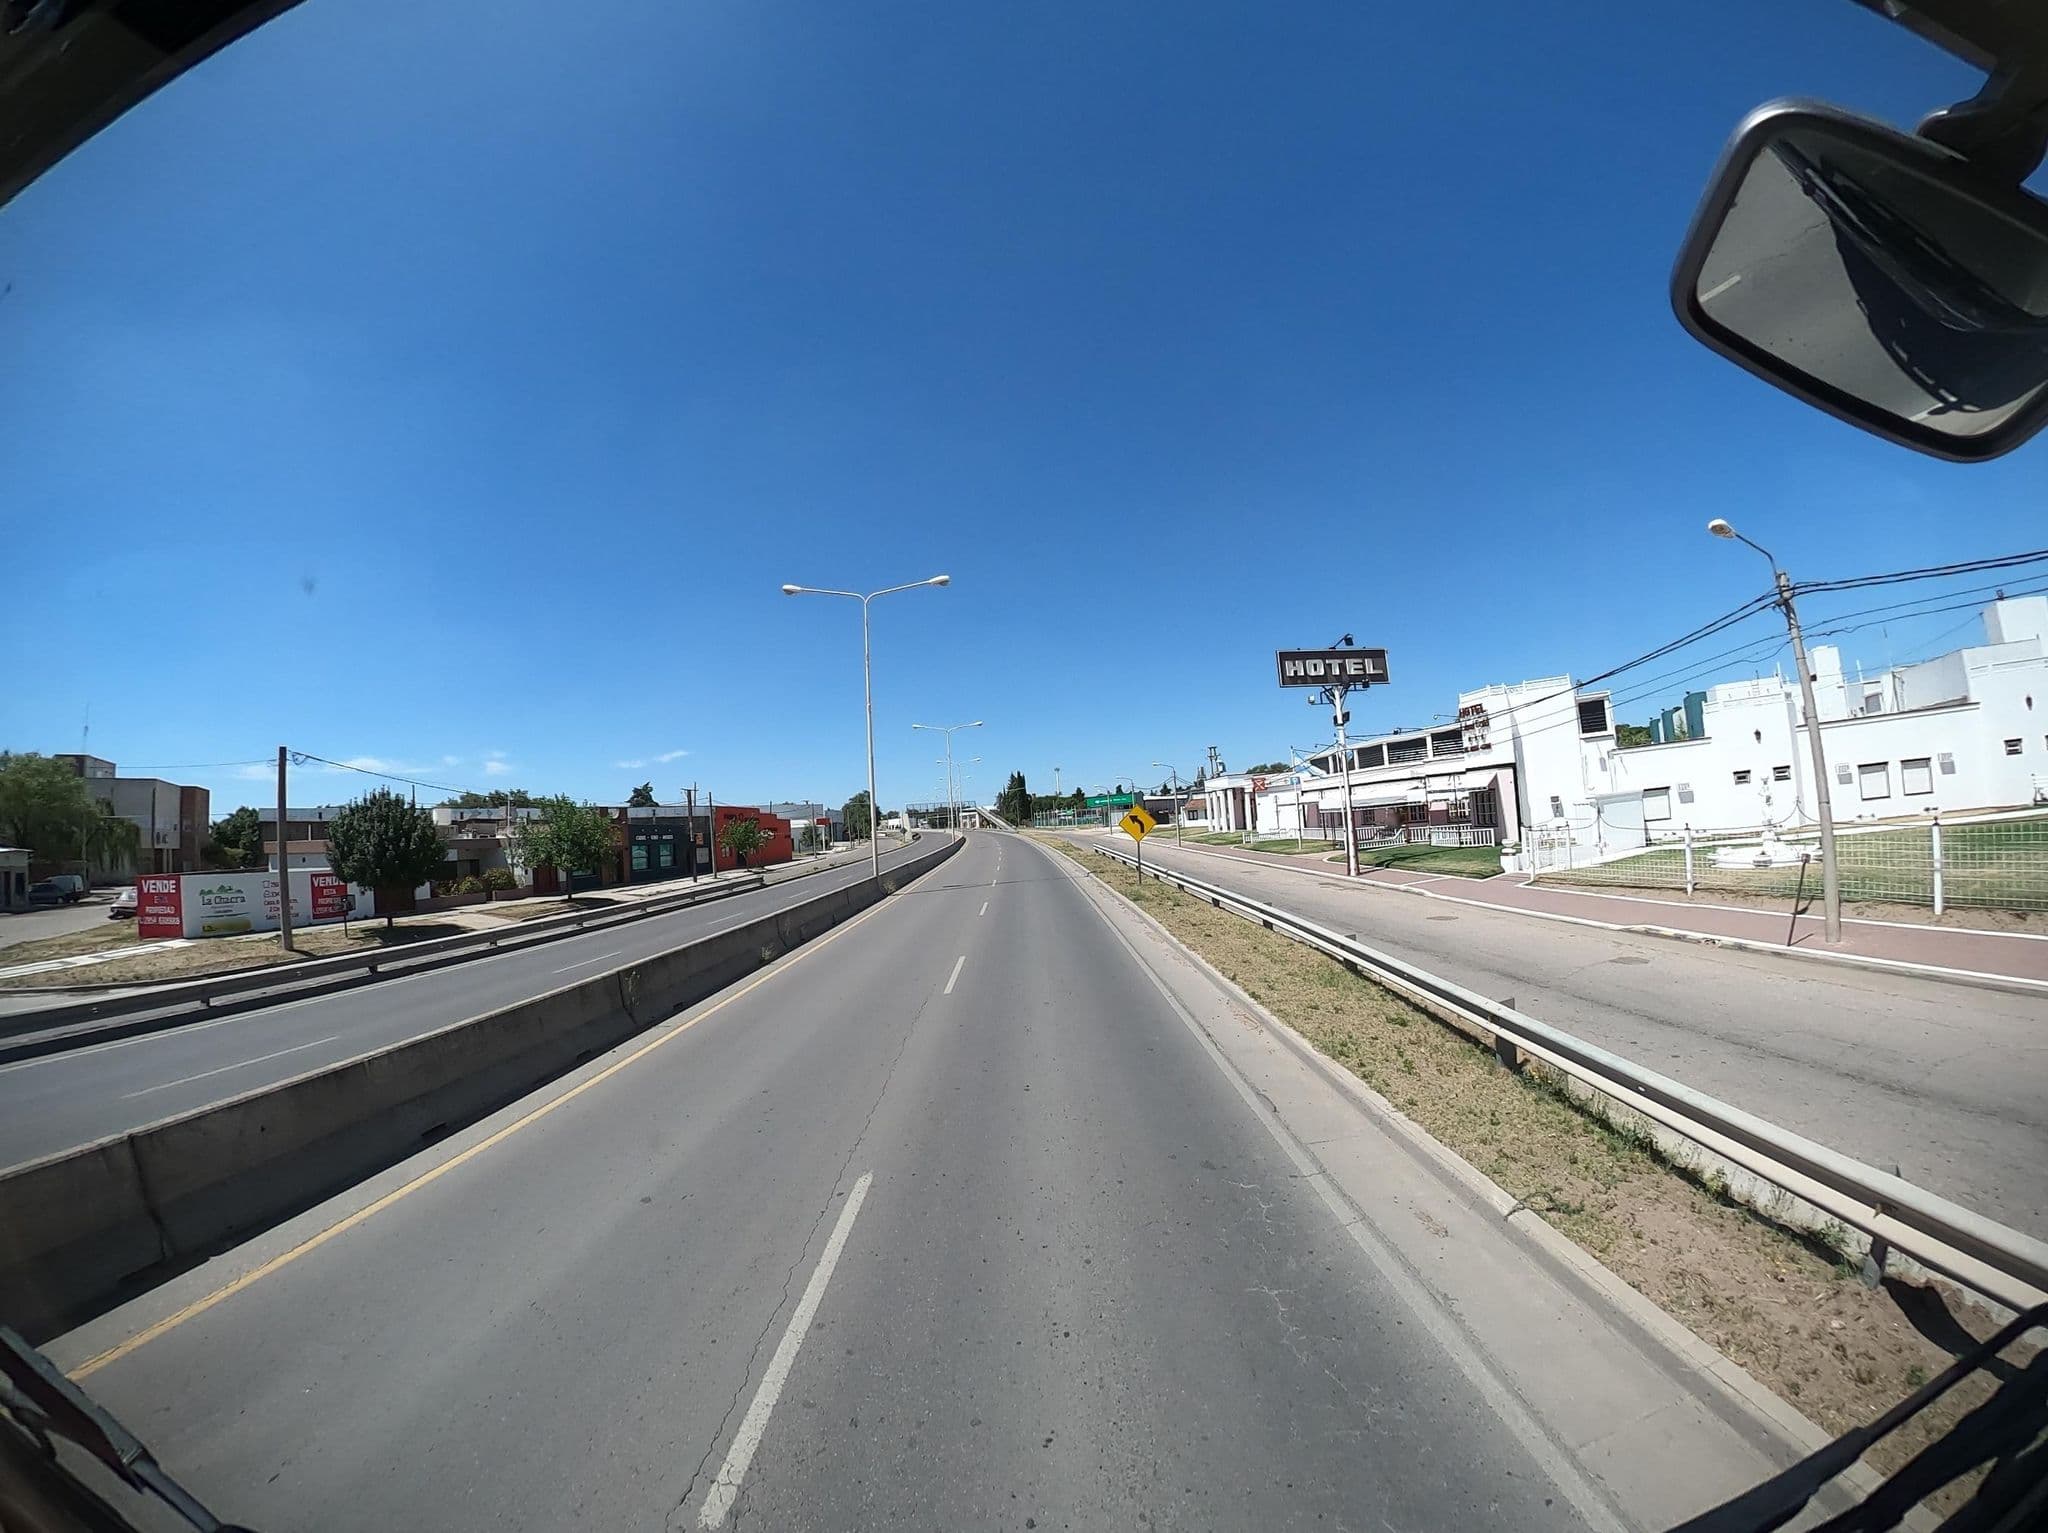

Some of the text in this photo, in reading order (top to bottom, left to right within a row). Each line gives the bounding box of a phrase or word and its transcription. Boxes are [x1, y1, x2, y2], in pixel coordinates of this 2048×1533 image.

[1285, 658, 1383, 677] HOTEL
[1459, 703, 1488, 719] HOTEL
[141, 879, 176, 893] VENDE
[202, 896, 213, 906] La
